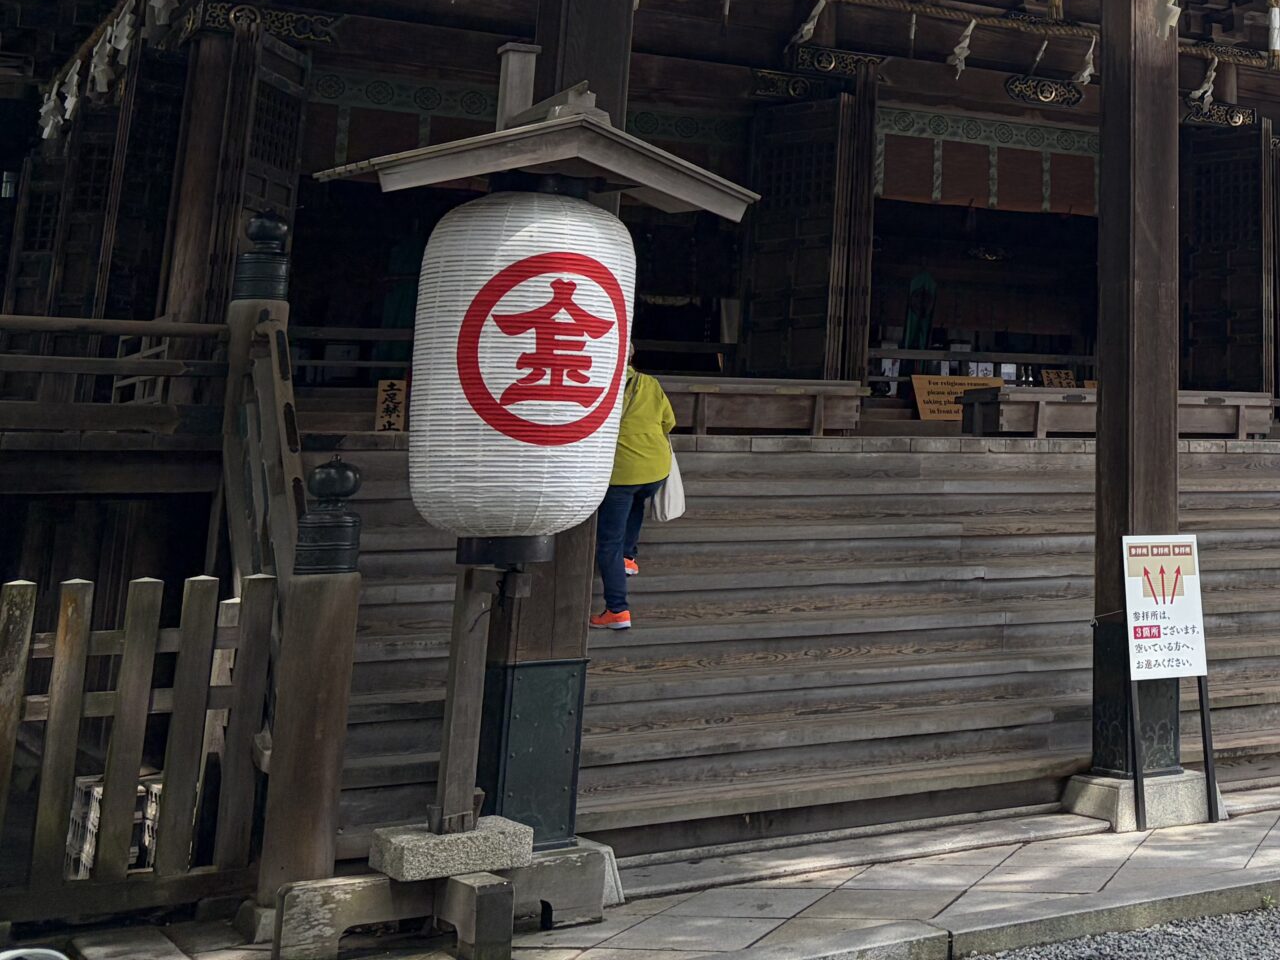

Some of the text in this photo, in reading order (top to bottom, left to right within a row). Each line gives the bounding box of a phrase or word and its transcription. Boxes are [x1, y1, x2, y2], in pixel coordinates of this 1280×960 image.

[491, 278, 615, 408] 金
[940, 379, 966, 388] religious
[377, 381, 402, 432] 土足禁止
[922, 398, 942, 406] taking
[1133, 611, 1170, 621] 参拝所は、
[1135, 641, 1194, 653] 空いている方へ、
[1136, 658, 1192, 669] お進みください。
